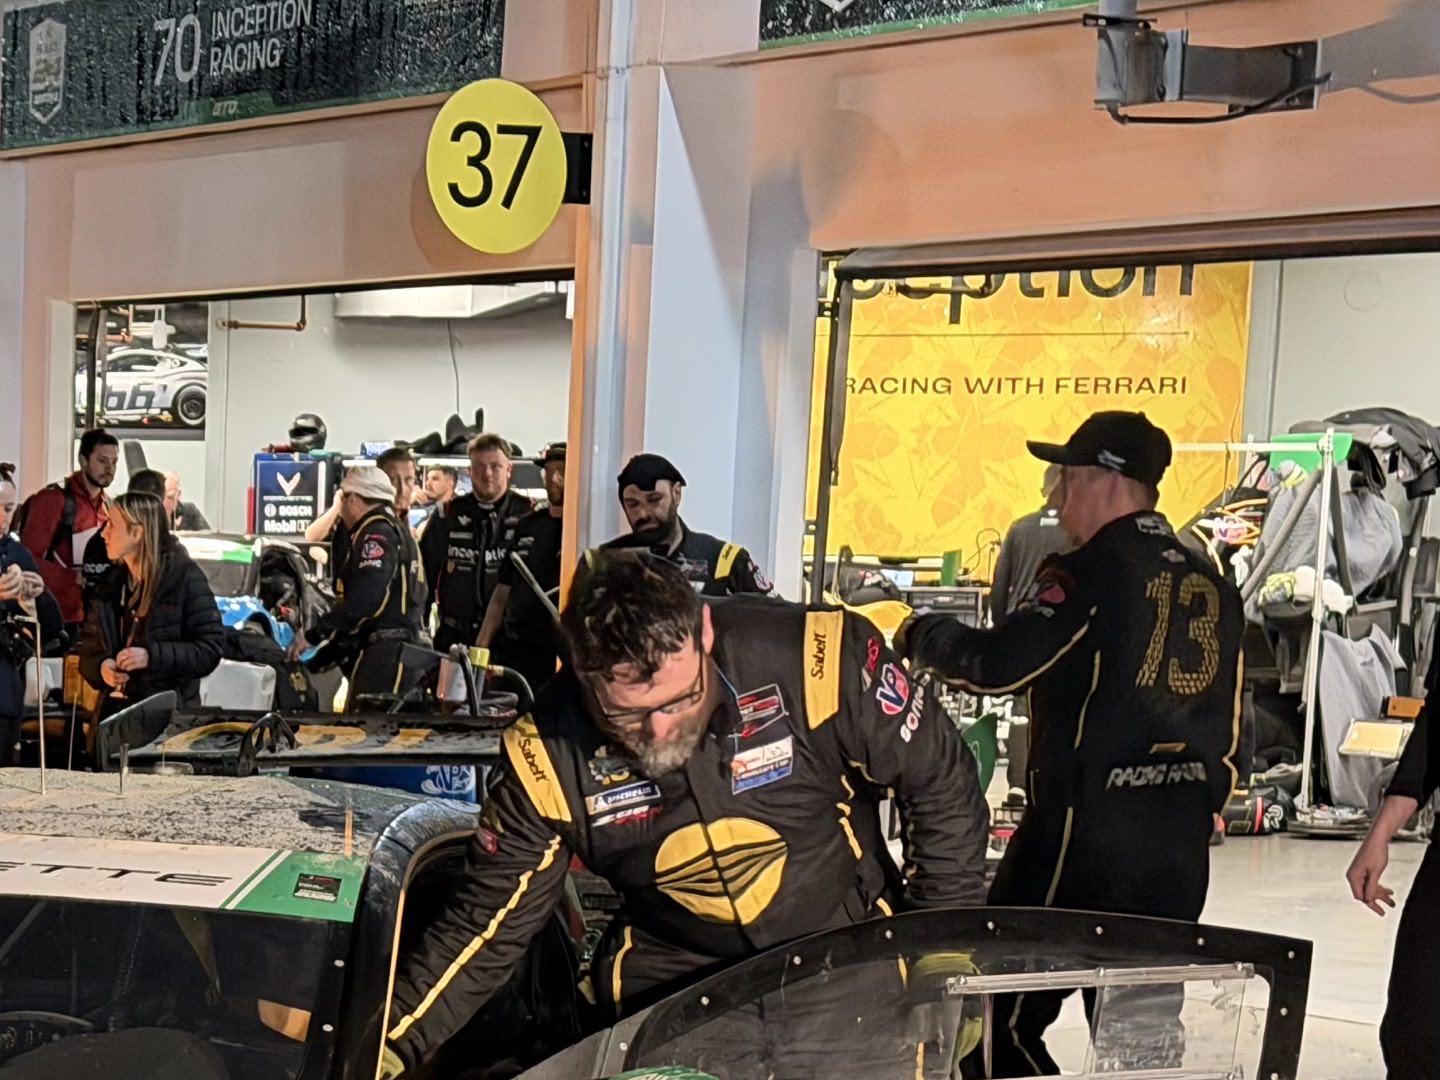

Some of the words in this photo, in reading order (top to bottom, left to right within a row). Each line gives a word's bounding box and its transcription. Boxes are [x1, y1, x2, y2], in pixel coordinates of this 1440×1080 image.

[154, 14, 201, 85] 70
[211, 0, 311, 41] INCEPTION
[210, 37, 282, 76] RACING
[447, 120, 543, 210] 37
[964, 376, 1044, 395] WITH
[1055, 376, 1187, 395] FERRARI
[264, 519, 297, 533] Mobil
[811, 632, 827, 680] Sabelt
[1136, 571, 1221, 694] 13
[518, 737, 550, 783] Sabelt
